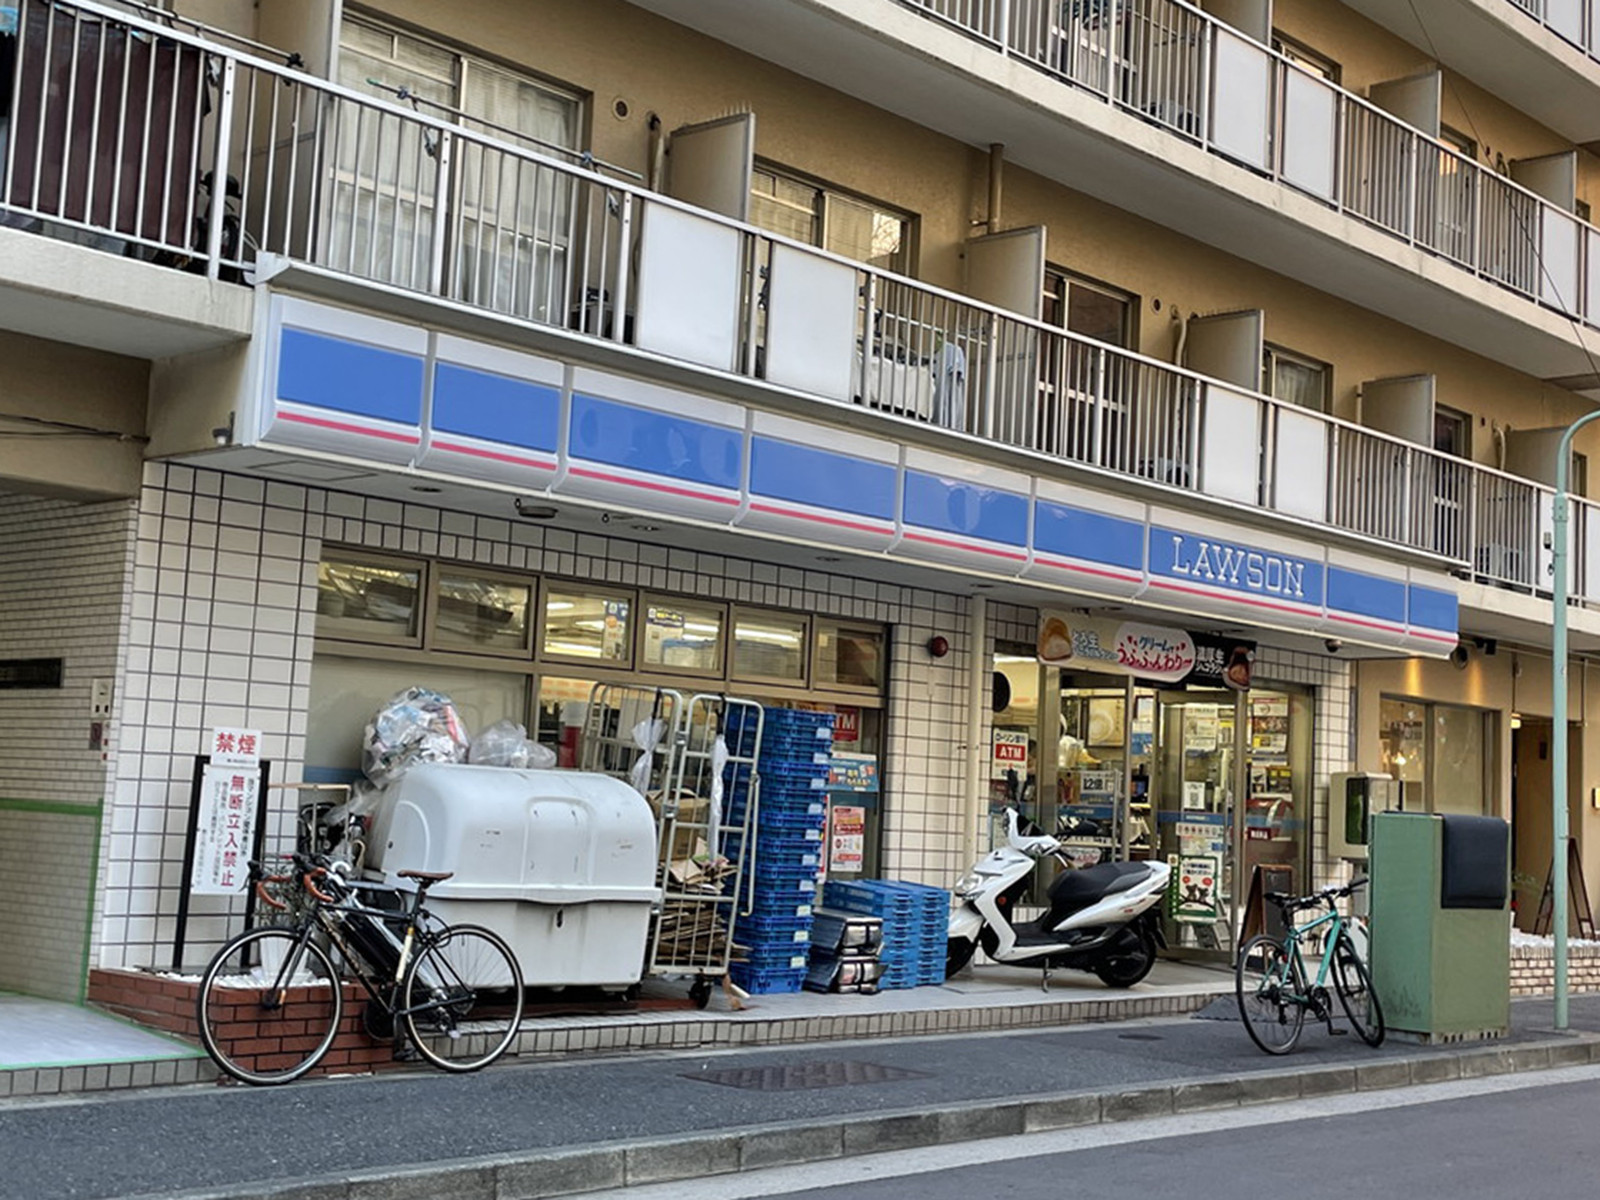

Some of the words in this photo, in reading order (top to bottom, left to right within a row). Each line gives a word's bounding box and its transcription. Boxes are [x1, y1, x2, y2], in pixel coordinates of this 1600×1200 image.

[1172, 536, 1305, 596] LAWSON
[833, 713, 855, 730] TM
[216, 732, 257, 755] 禁煙
[999, 745, 1023, 759] ATM
[220, 775, 245, 887] 無断立入禁止
